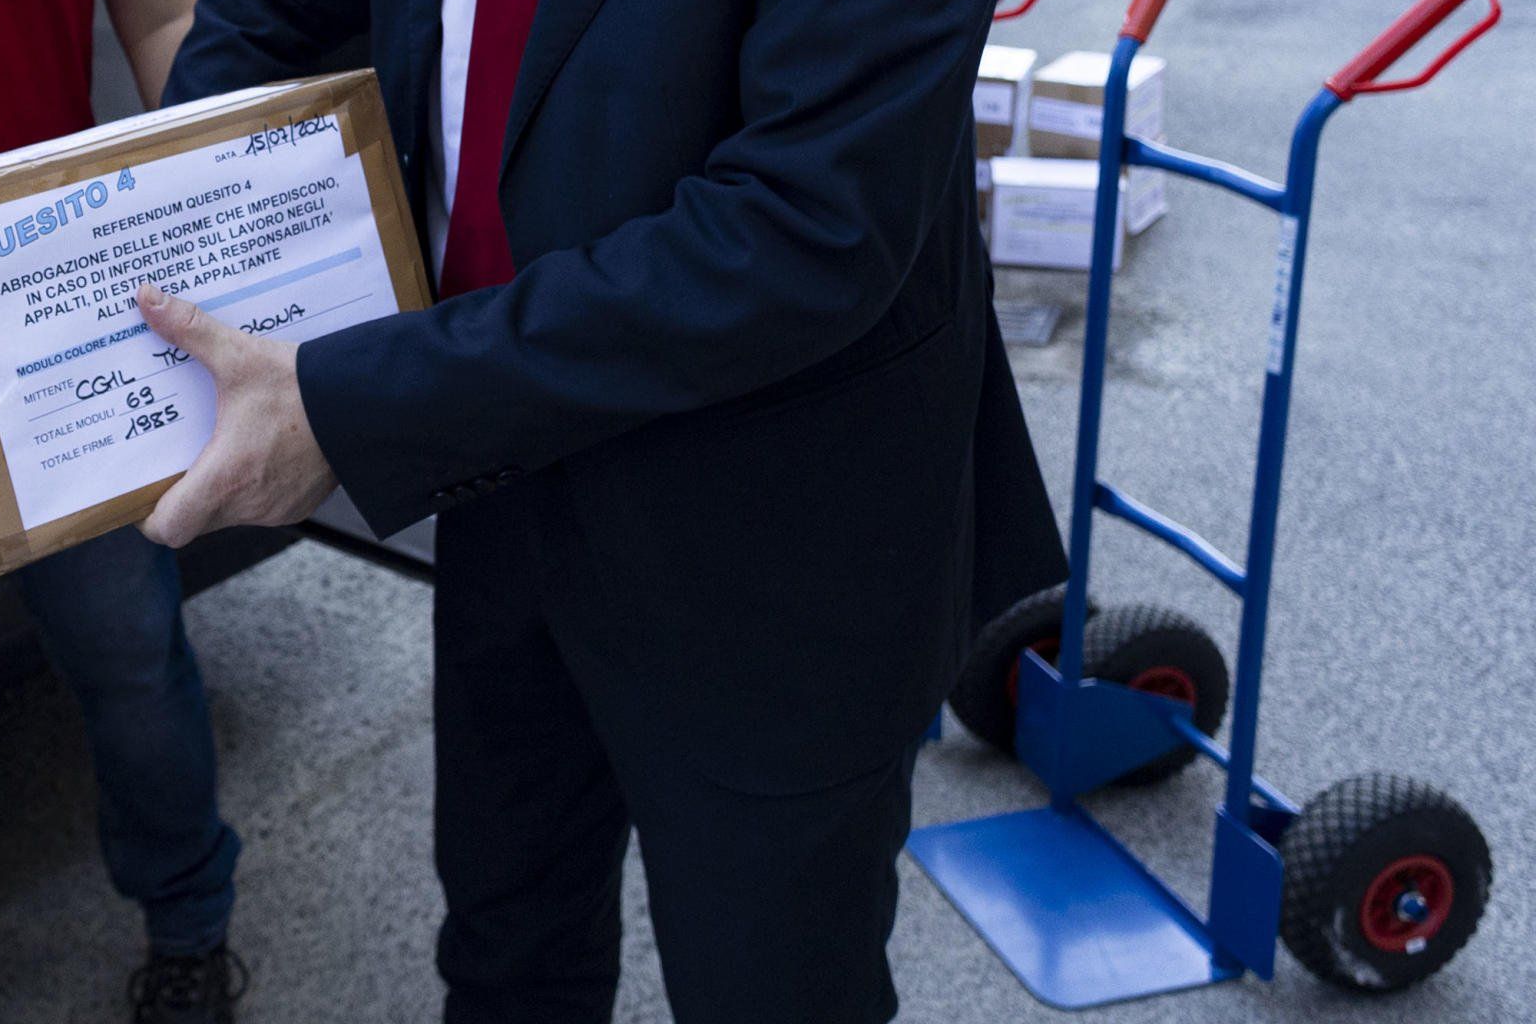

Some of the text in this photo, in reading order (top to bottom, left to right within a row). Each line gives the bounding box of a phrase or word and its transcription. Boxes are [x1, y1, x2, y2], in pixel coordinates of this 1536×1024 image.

[117, 166, 137, 192] 4
[215, 151, 237, 163] DATA
[0, 176, 340, 296] ABROGAZIONE DELLE NORME CHE IMPEDISCONO,
[92, 179, 252, 239] REFERENDUM QUESITO 4
[24, 211, 333, 327] APPALTI, DI ESTENDERE LA RESPONSABILITA'
[26, 197, 325, 306] IN CASO DI INFORTUNIO SUL LAVORO NEGLI
[193, 248, 282, 288] APPALTANTE
[16, 322, 151, 378] MODULO COLORE AZZURR
[23, 378, 75, 405] MITTENTE
[75, 370, 135, 401] CGIL
[34, 386, 155, 445] TOTALE MODULI 69
[40, 404, 179, 470] TOTALE FIRME 1985
